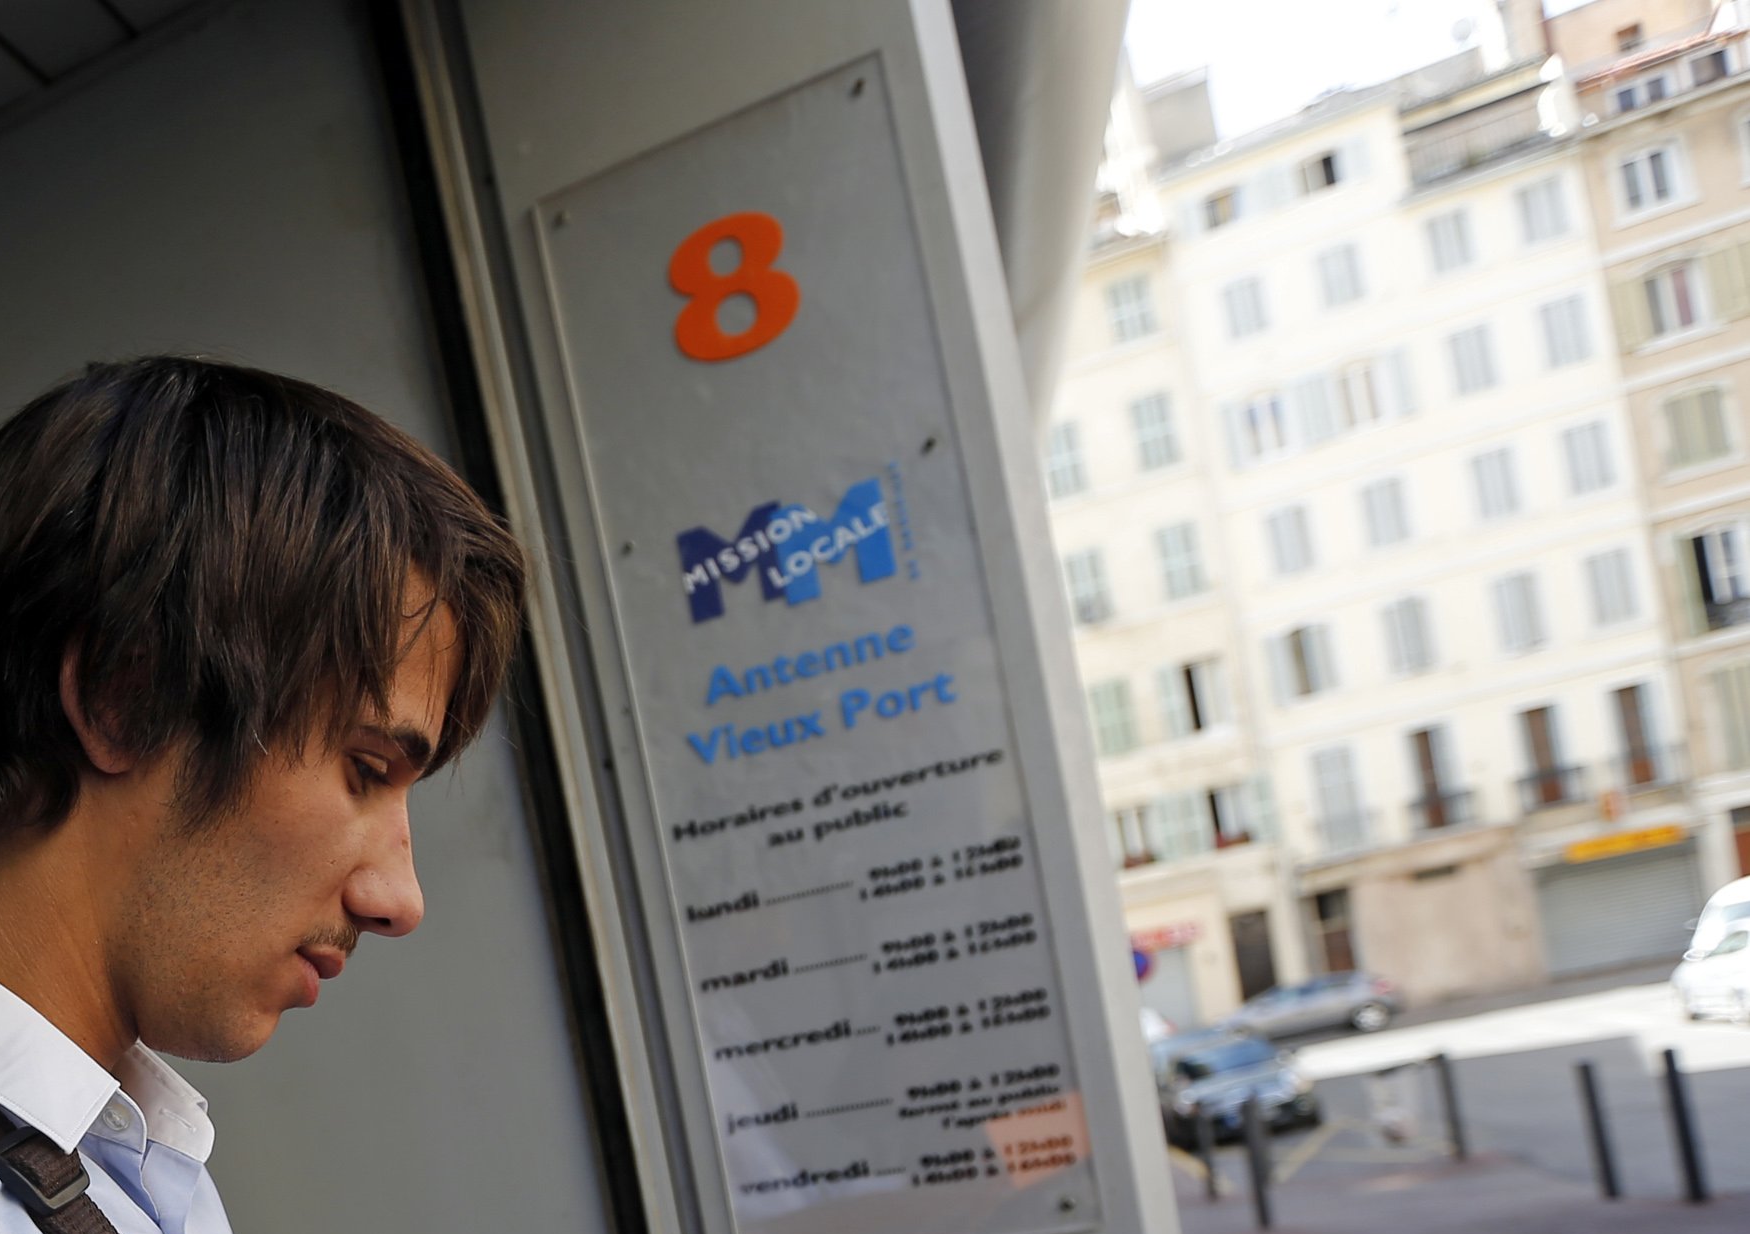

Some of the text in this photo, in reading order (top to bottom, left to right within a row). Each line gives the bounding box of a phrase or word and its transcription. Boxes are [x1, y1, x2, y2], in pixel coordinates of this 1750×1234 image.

[668, 211, 801, 364] 8
[683, 507, 817, 594] MISSION
[767, 501, 890, 588] LOCALE
[706, 623, 916, 706] Antenne
[687, 673, 957, 766] Vieux Port
[672, 747, 1003, 843] Horaires d'ouverture
[767, 800, 908, 849] au public
[688, 891, 760, 923] lundi
[700, 960, 788, 993] mardi
[714, 1019, 851, 1061] mercredi
[727, 1105, 798, 1135] jeudi
[739, 1162, 869, 1196] vendredi
